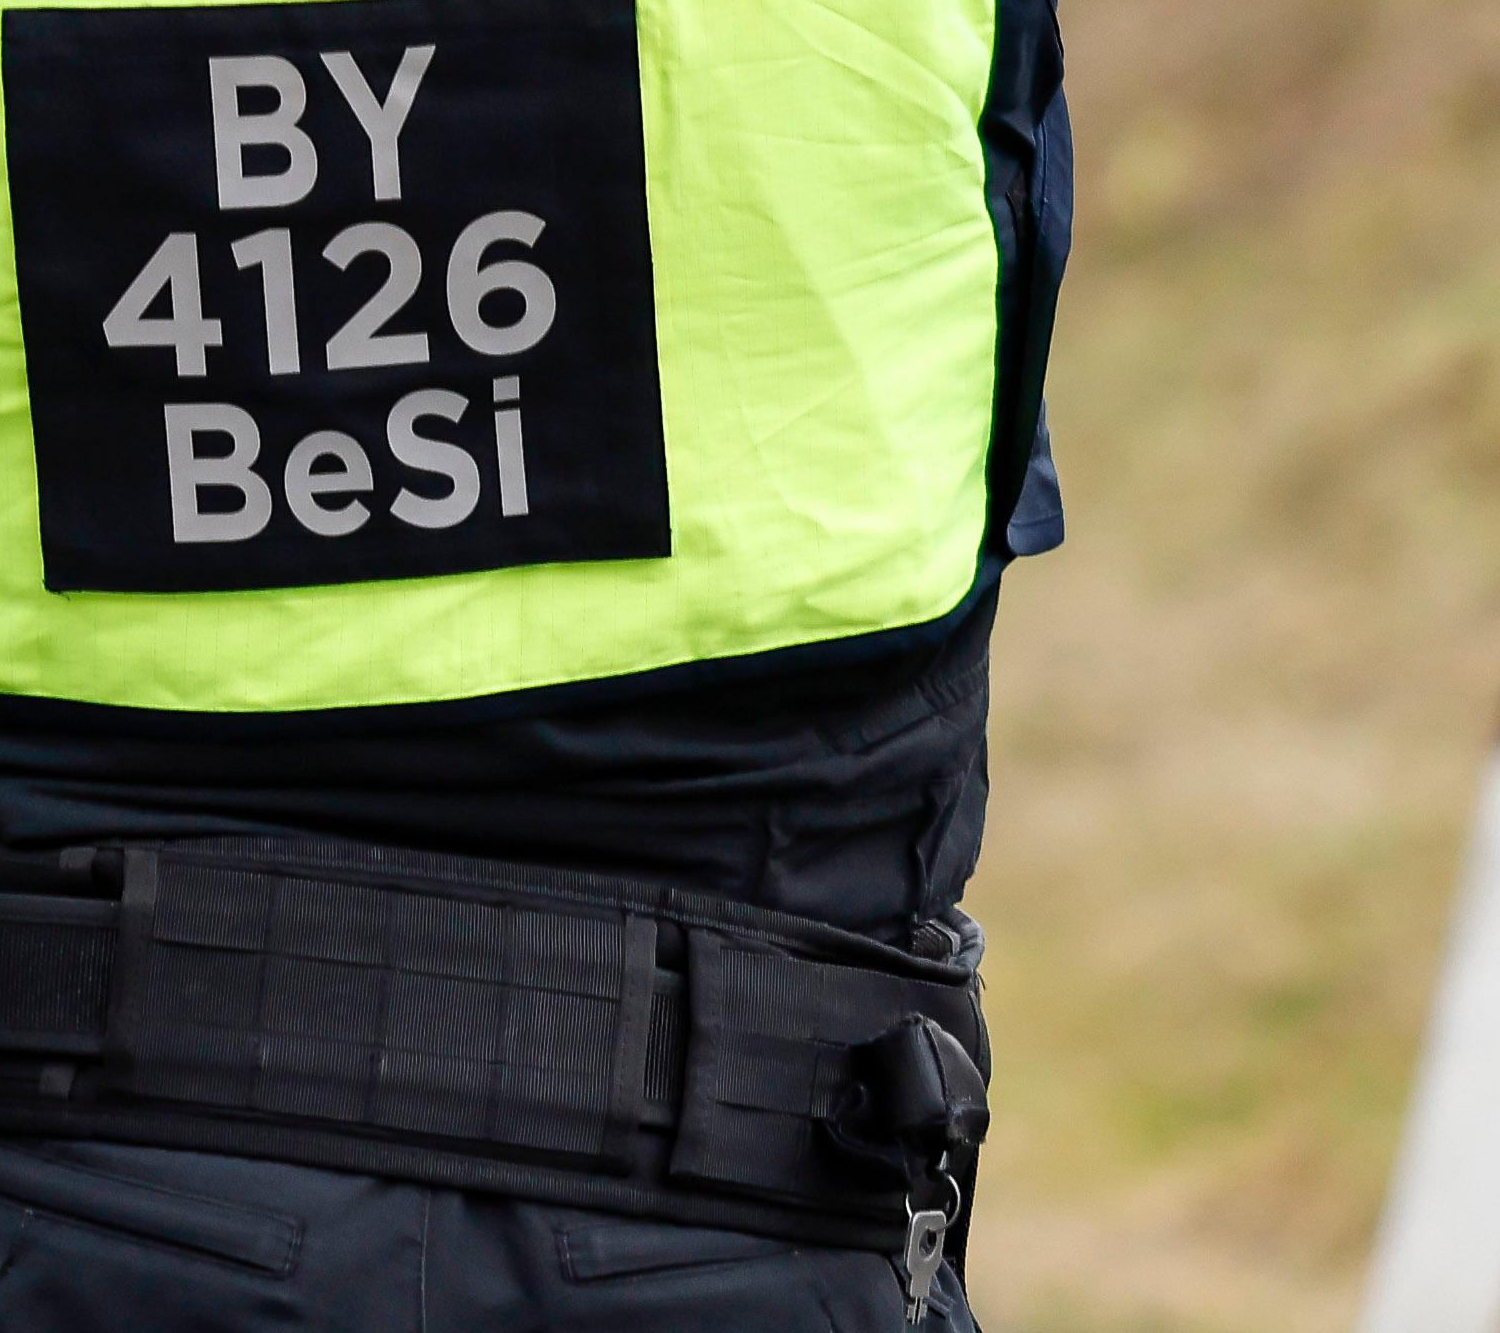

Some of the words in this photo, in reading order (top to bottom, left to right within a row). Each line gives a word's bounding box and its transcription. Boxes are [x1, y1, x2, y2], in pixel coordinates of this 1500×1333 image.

[208, 44, 436, 210] BY
[102, 211, 557, 377] 4126
[163, 375, 529, 543] BeSi
